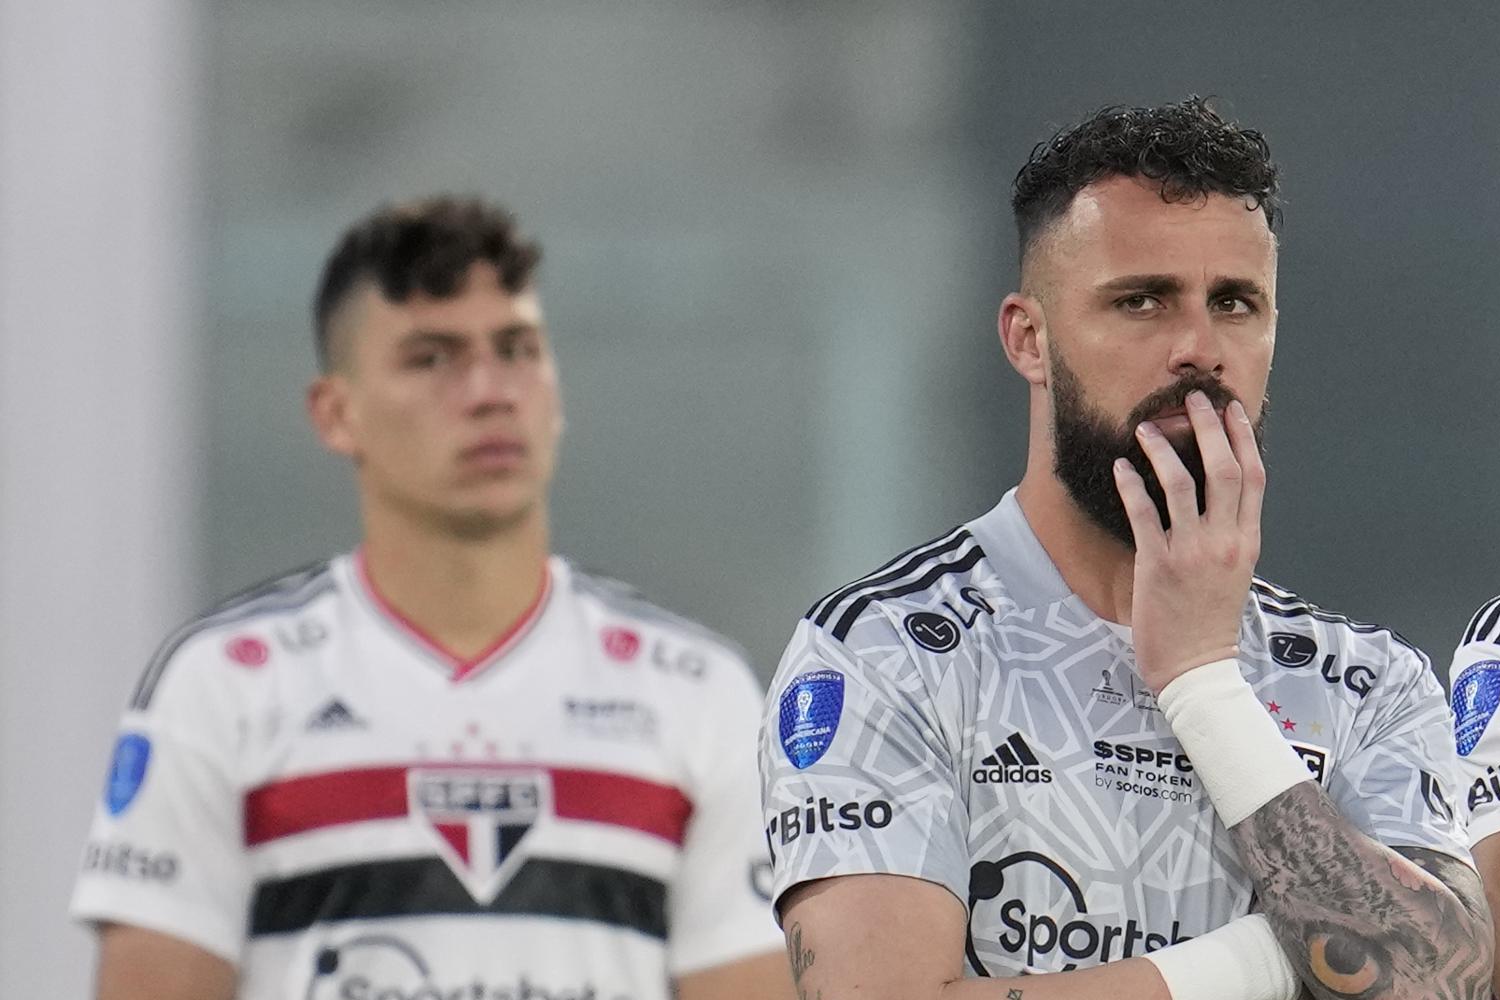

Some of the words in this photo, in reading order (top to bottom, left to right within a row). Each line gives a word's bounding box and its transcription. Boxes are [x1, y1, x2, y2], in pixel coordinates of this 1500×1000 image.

[942, 587, 996, 630] LG
[1321, 655, 1376, 700] LG
[972, 765, 1052, 784] adidas
[1095, 762, 1129, 777] FAN
[1135, 769, 1193, 788] TOKEN
[1095, 775, 1113, 790] by
[780, 795, 893, 846] Bitso
